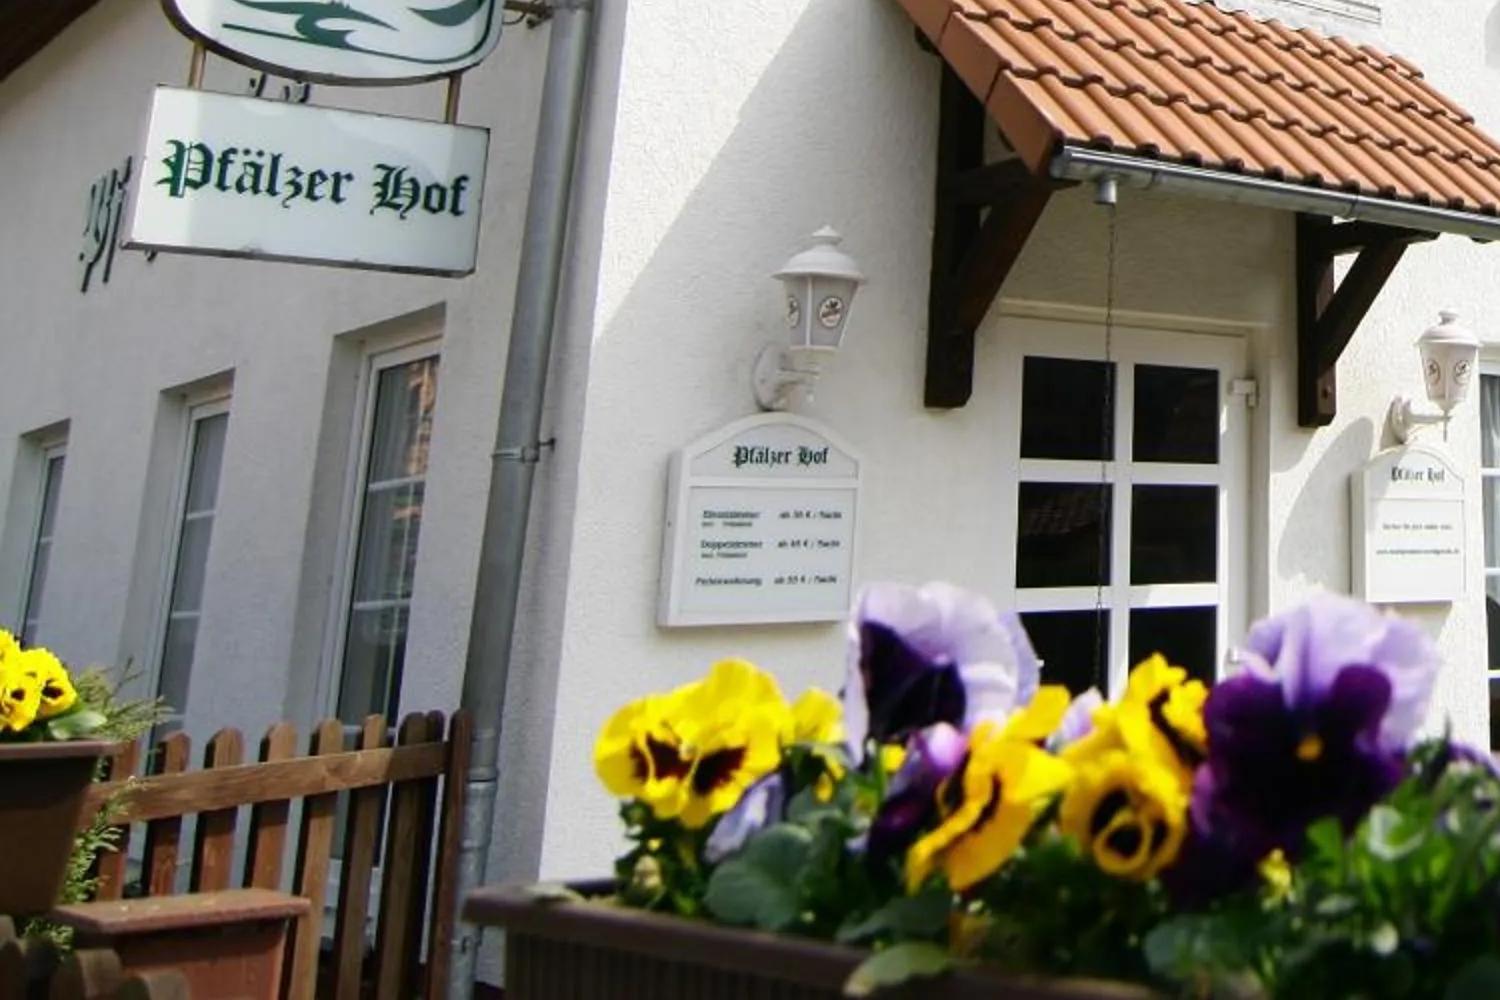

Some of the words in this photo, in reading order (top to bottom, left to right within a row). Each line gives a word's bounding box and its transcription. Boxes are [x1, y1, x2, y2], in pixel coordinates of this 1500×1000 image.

[156, 137, 355, 209] Pfälzer
[370, 161, 471, 220] Hof
[732, 446, 793, 468] Pfälzer
